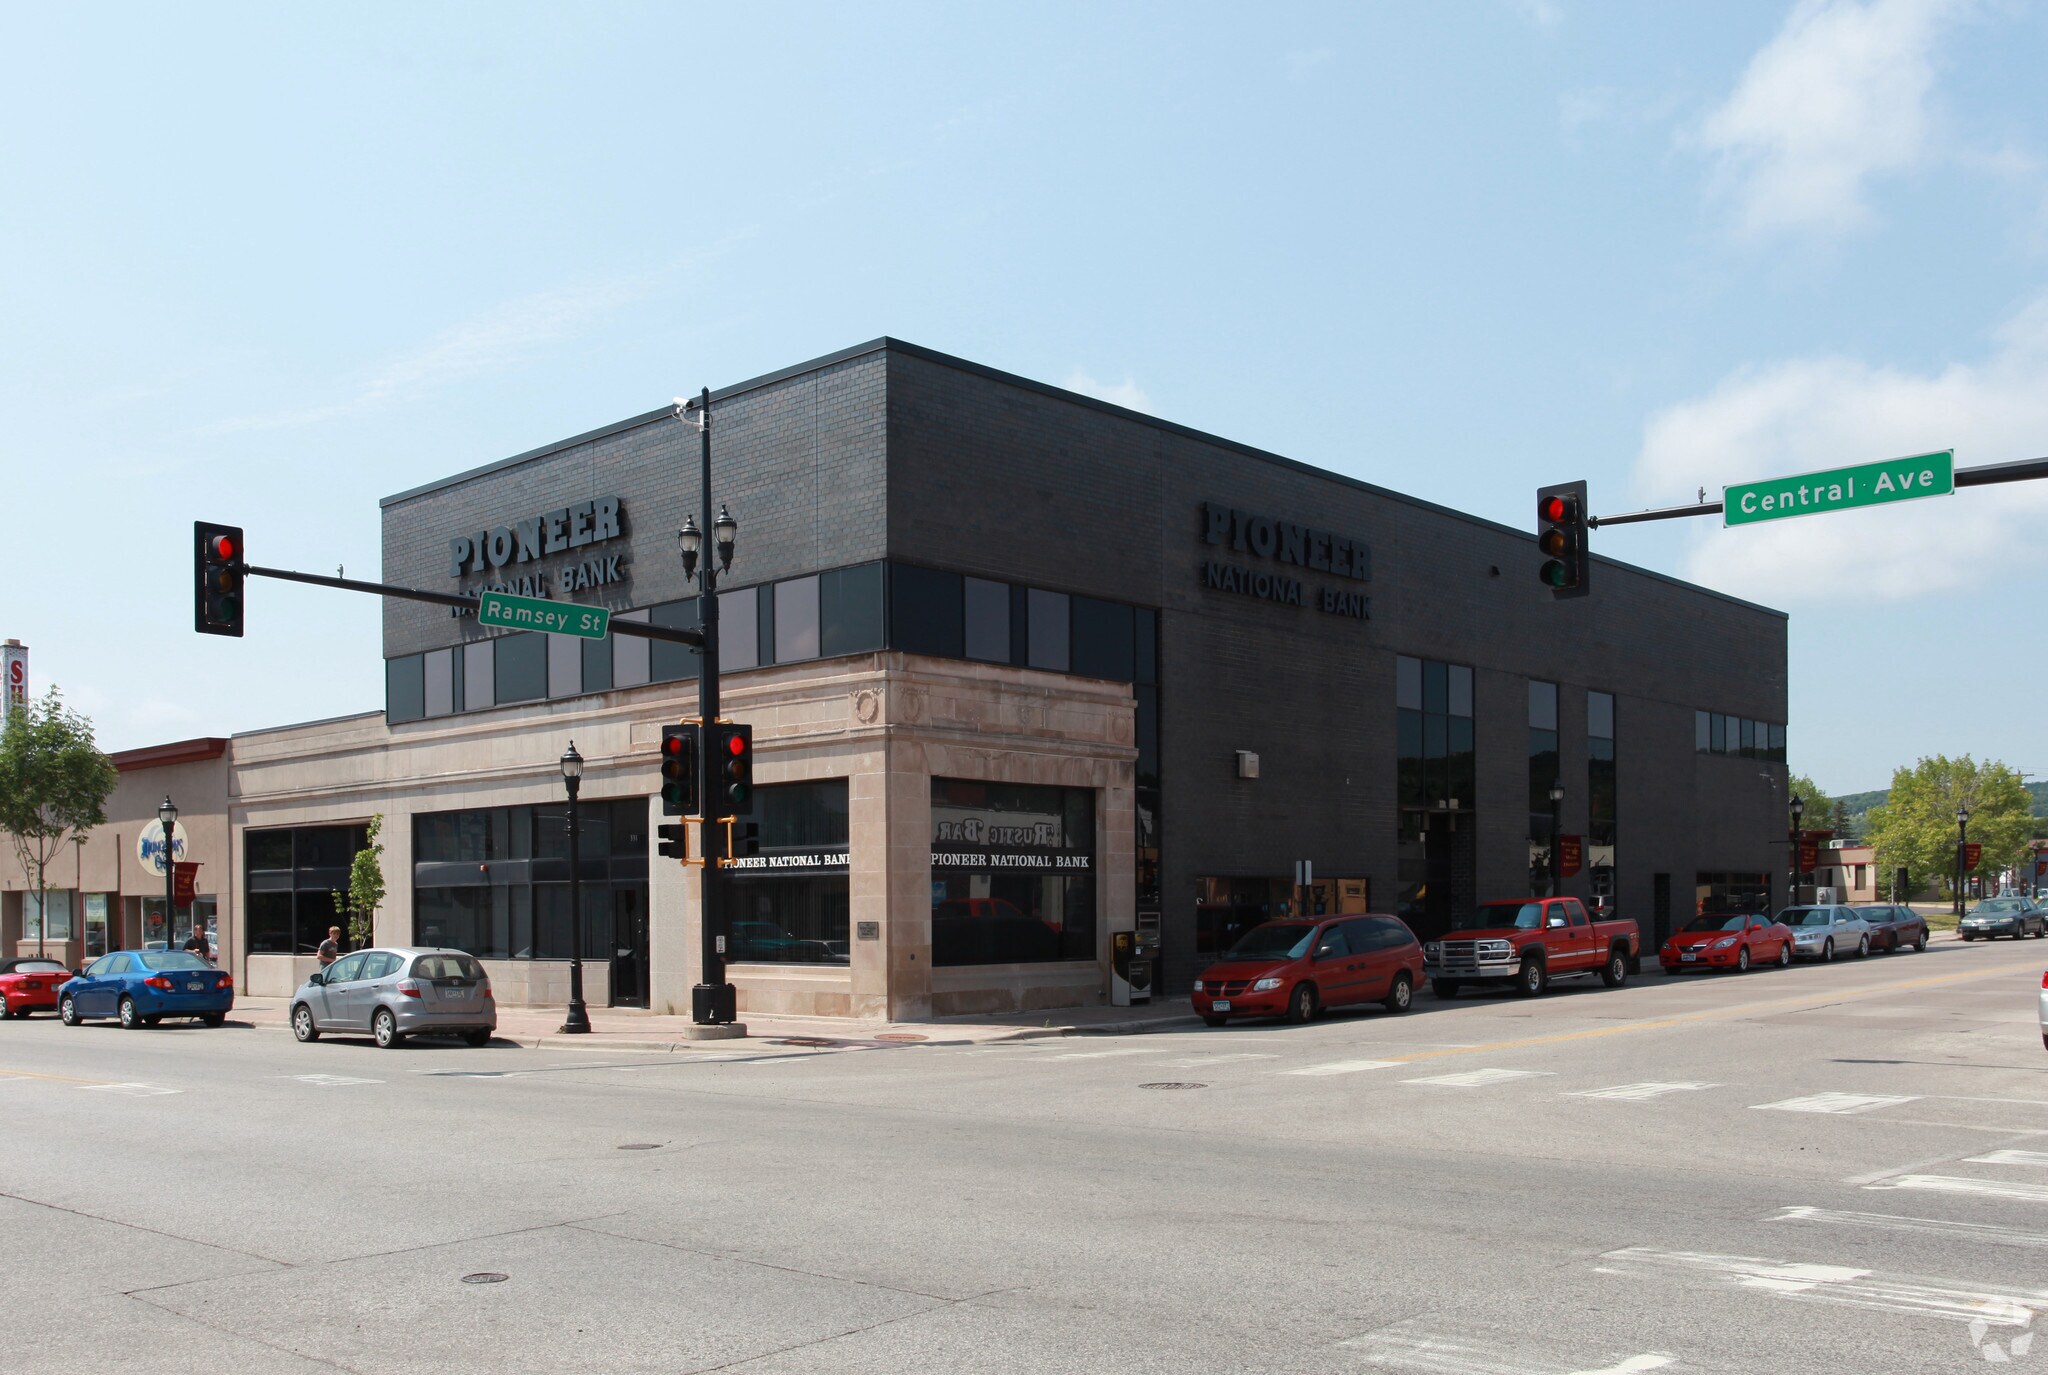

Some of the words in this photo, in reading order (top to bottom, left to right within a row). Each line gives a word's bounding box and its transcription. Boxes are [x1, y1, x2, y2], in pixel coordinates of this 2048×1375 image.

[1740, 477, 1855, 514] Central
[1873, 469, 1935, 495] Ave
[450, 494, 621, 578] PIONEER
[1203, 501, 1373, 582] PIONEER
[561, 554, 624, 594] BANK
[1205, 560, 1312, 607] NATIONAL
[1321, 584, 1373, 620] BANK
[486, 600, 569, 631] Ramsey
[579, 613, 601, 633] St
[769, 855, 821, 868] NATIONAL
[931, 853, 987, 866] PIONEER
[990, 854, 1052, 867] NATIONAL
[1055, 855, 1089, 868] BANK
